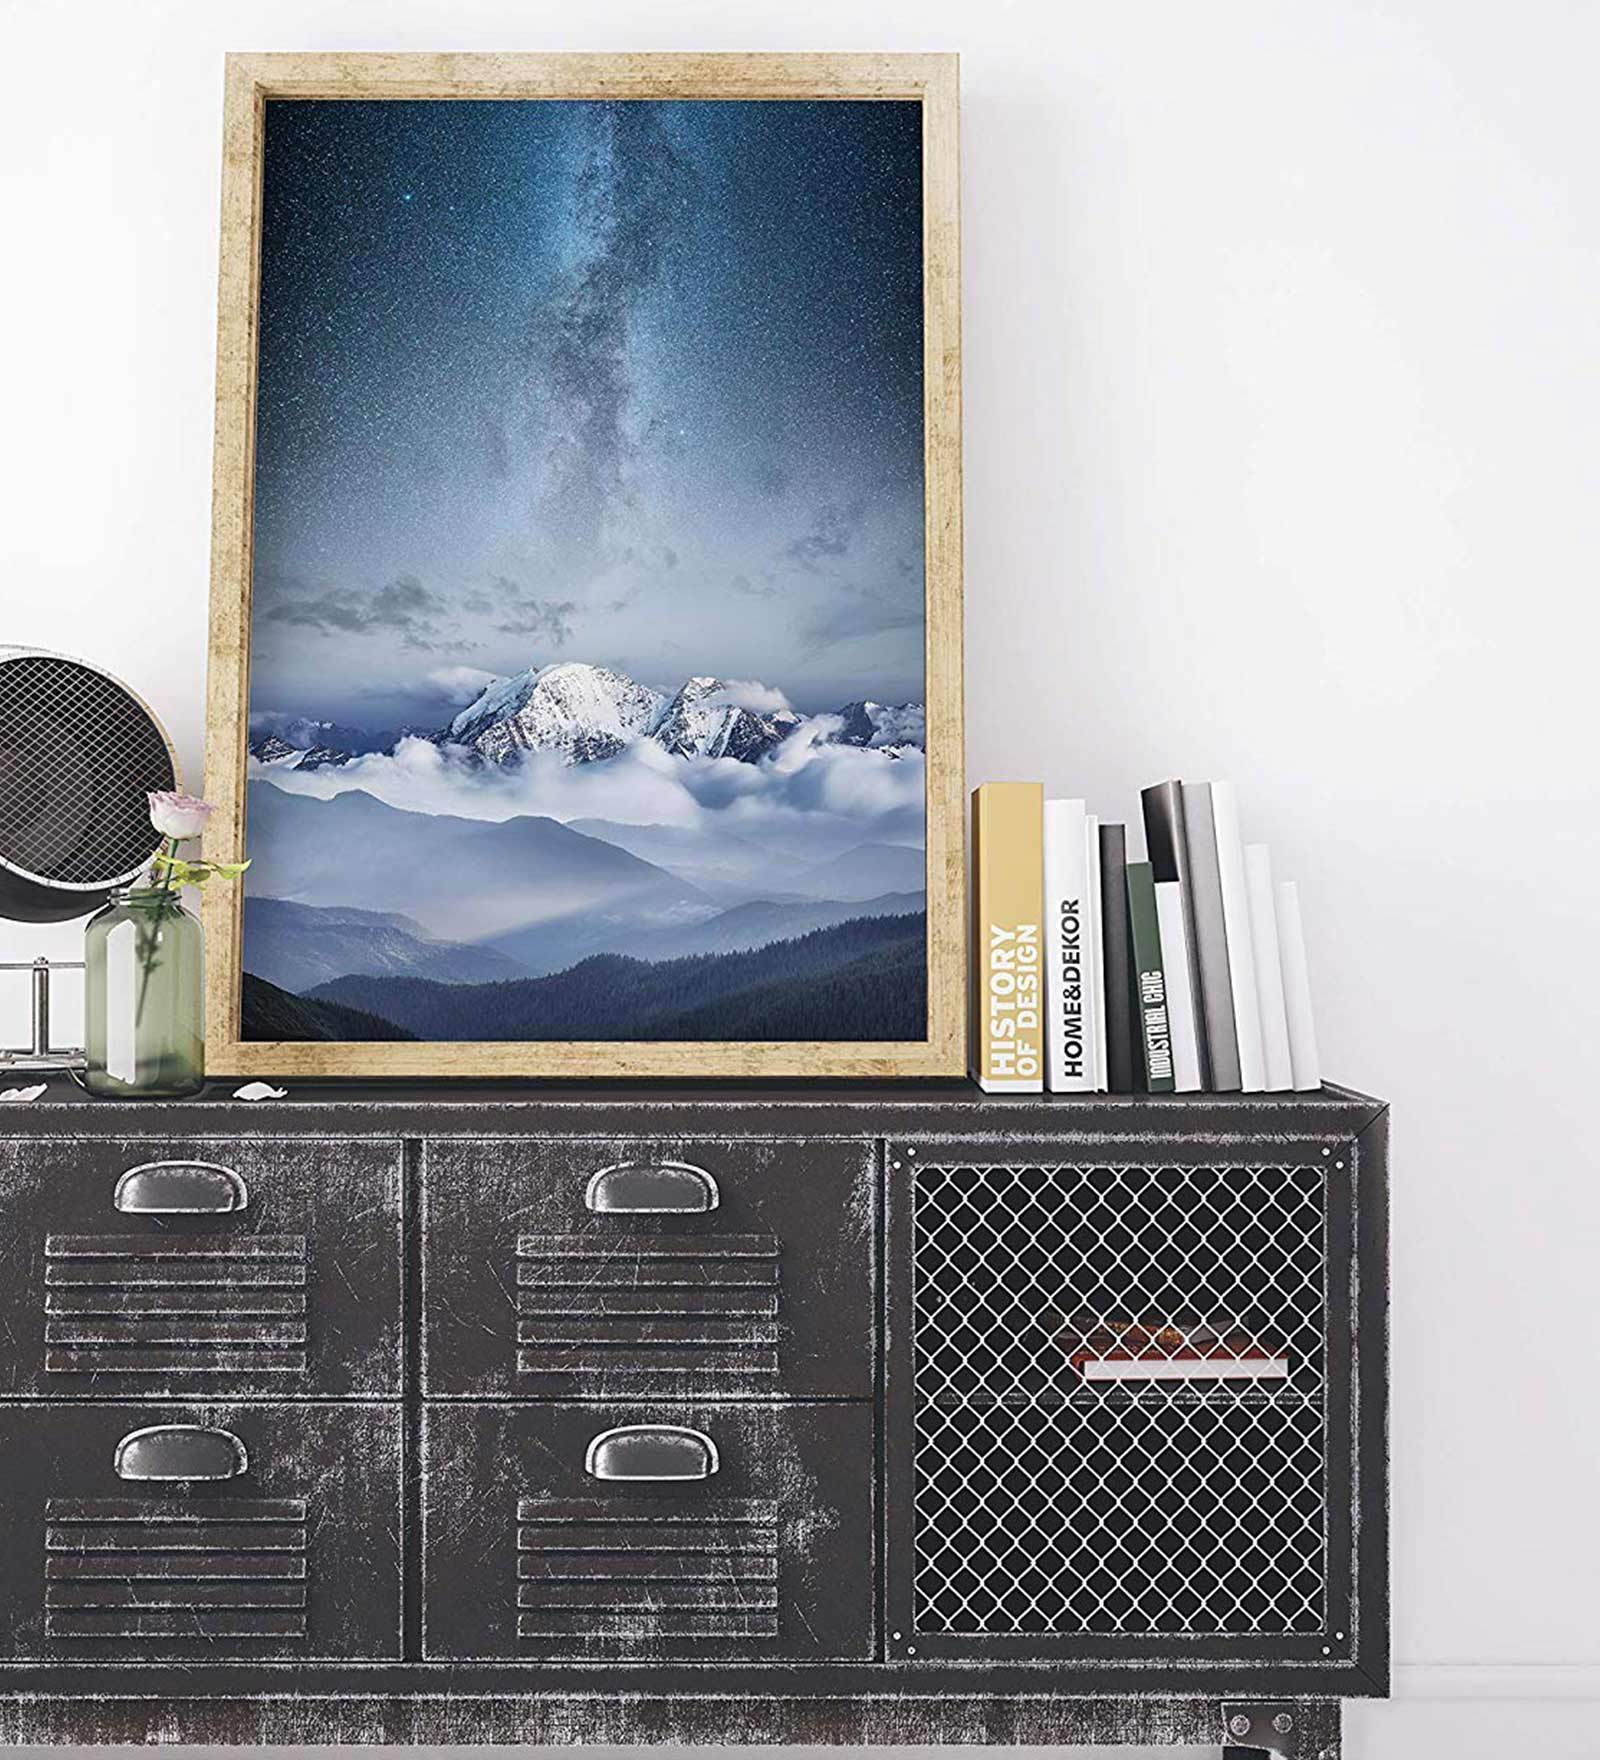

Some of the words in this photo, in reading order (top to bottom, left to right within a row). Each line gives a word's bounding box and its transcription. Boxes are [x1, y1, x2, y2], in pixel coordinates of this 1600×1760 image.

[990, 925, 1016, 1076] HISTORY
[1017, 924, 1037, 1028] DESIGN
[1061, 899, 1083, 1077] HOME&DEKOR
[1141, 971, 1164, 1003] CHIC
[1017, 1040, 1037, 1077] OF
[1144, 1005, 1172, 1079] INDUSTRIAL
